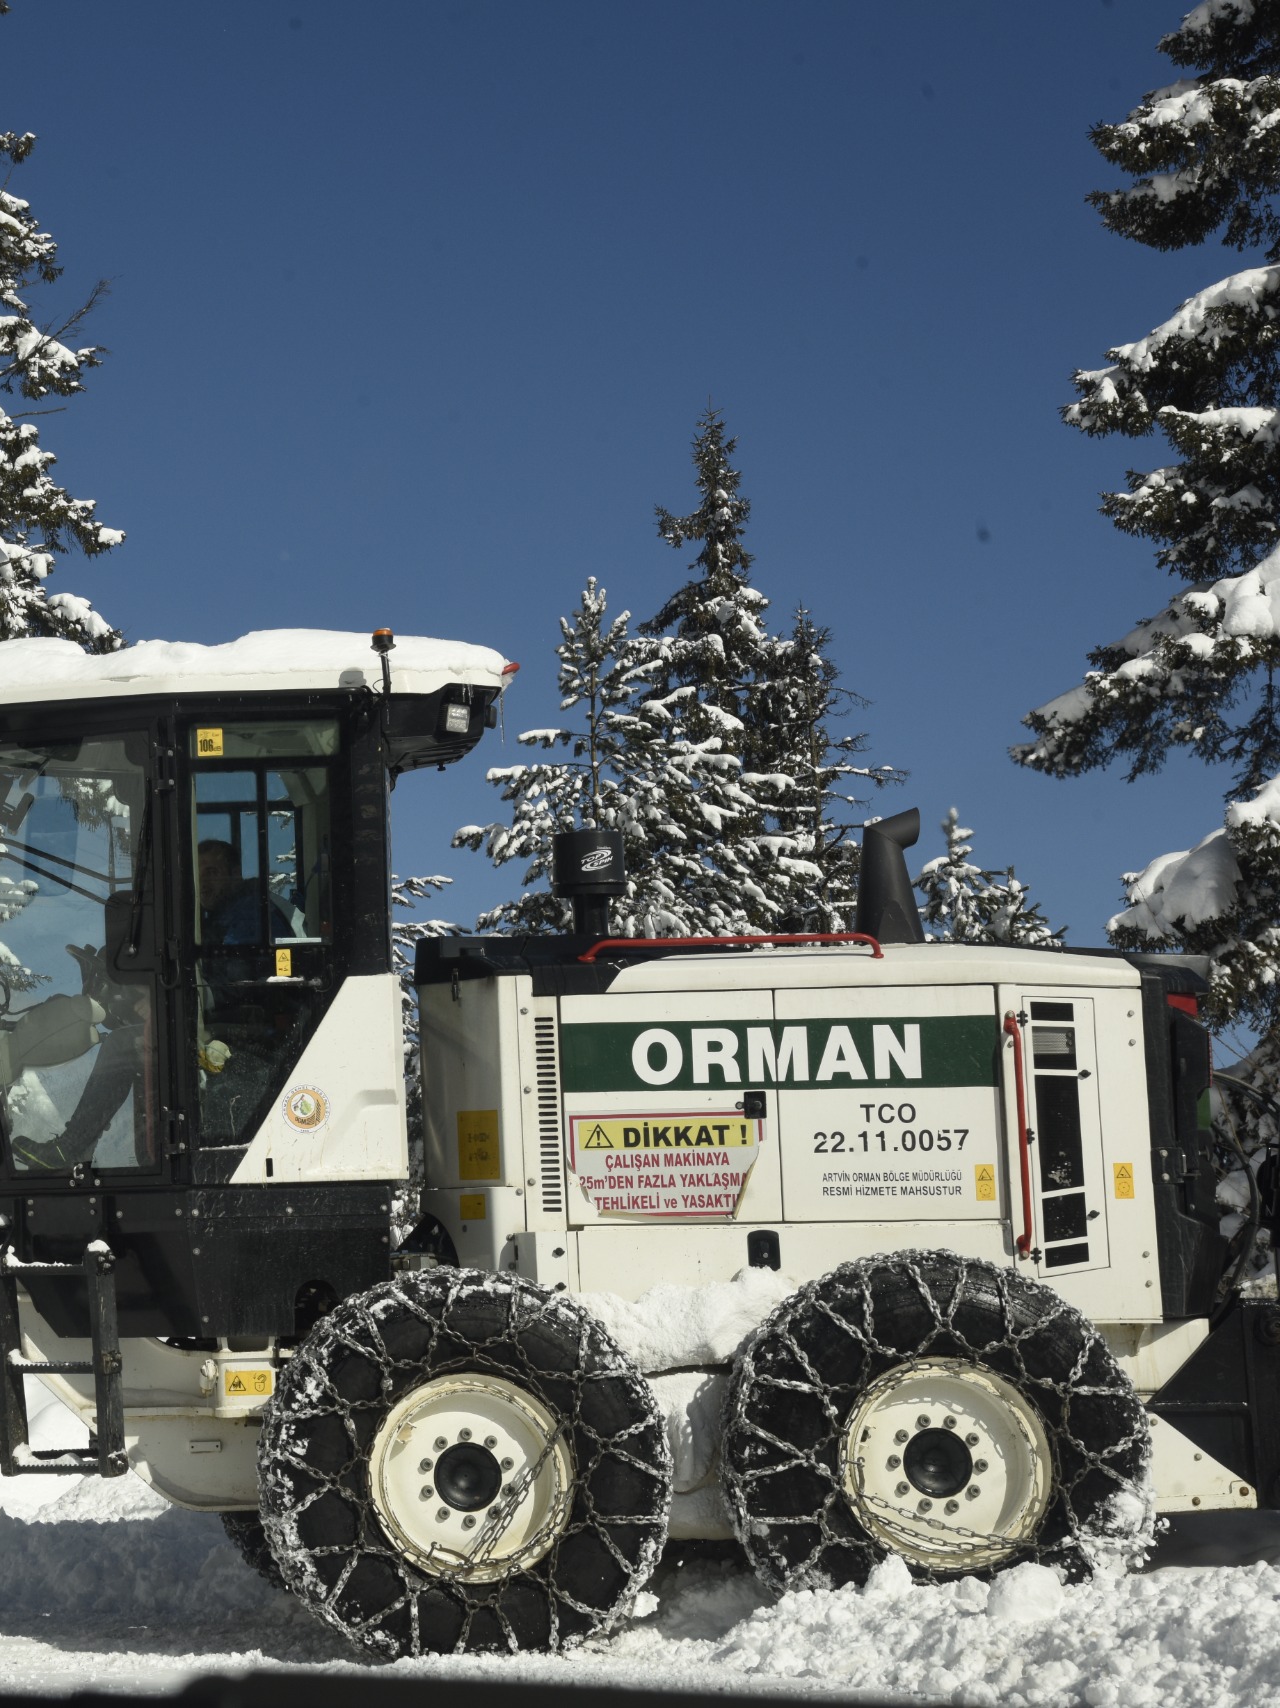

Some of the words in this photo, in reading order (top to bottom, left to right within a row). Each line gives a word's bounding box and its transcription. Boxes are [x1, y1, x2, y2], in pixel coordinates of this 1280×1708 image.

[581, 853, 601, 864] TOP
[593, 856, 613, 866] SPIN
[631, 1024, 922, 1085] ORMAN
[860, 1103, 916, 1123] TCO
[623, 1122, 730, 1147] DİKKAT
[740, 1124, 747, 1145] !
[813, 1129, 969, 1153] 22.11.0057
[605, 1153, 660, 1172] ÇALIŞAN
[664, 1149, 730, 1168] MAKİNAYA
[638, 1174, 676, 1188] FAZLA
[822, 1170, 850, 1182] ARTVİN
[852, 1172, 880, 1182] ORMAN
[883, 1170, 910, 1182] BÖLGE
[912, 1169, 962, 1181] MÜDÜRLÜĞÜ
[822, 1184, 852, 1196] RESMİ
[855, 1184, 897, 1196] HİZMETE
[900, 1185, 962, 1196] MAHSUSTUR
[594, 1192, 660, 1210] TEHLİKELİ
[664, 1198, 677, 1209] ve
